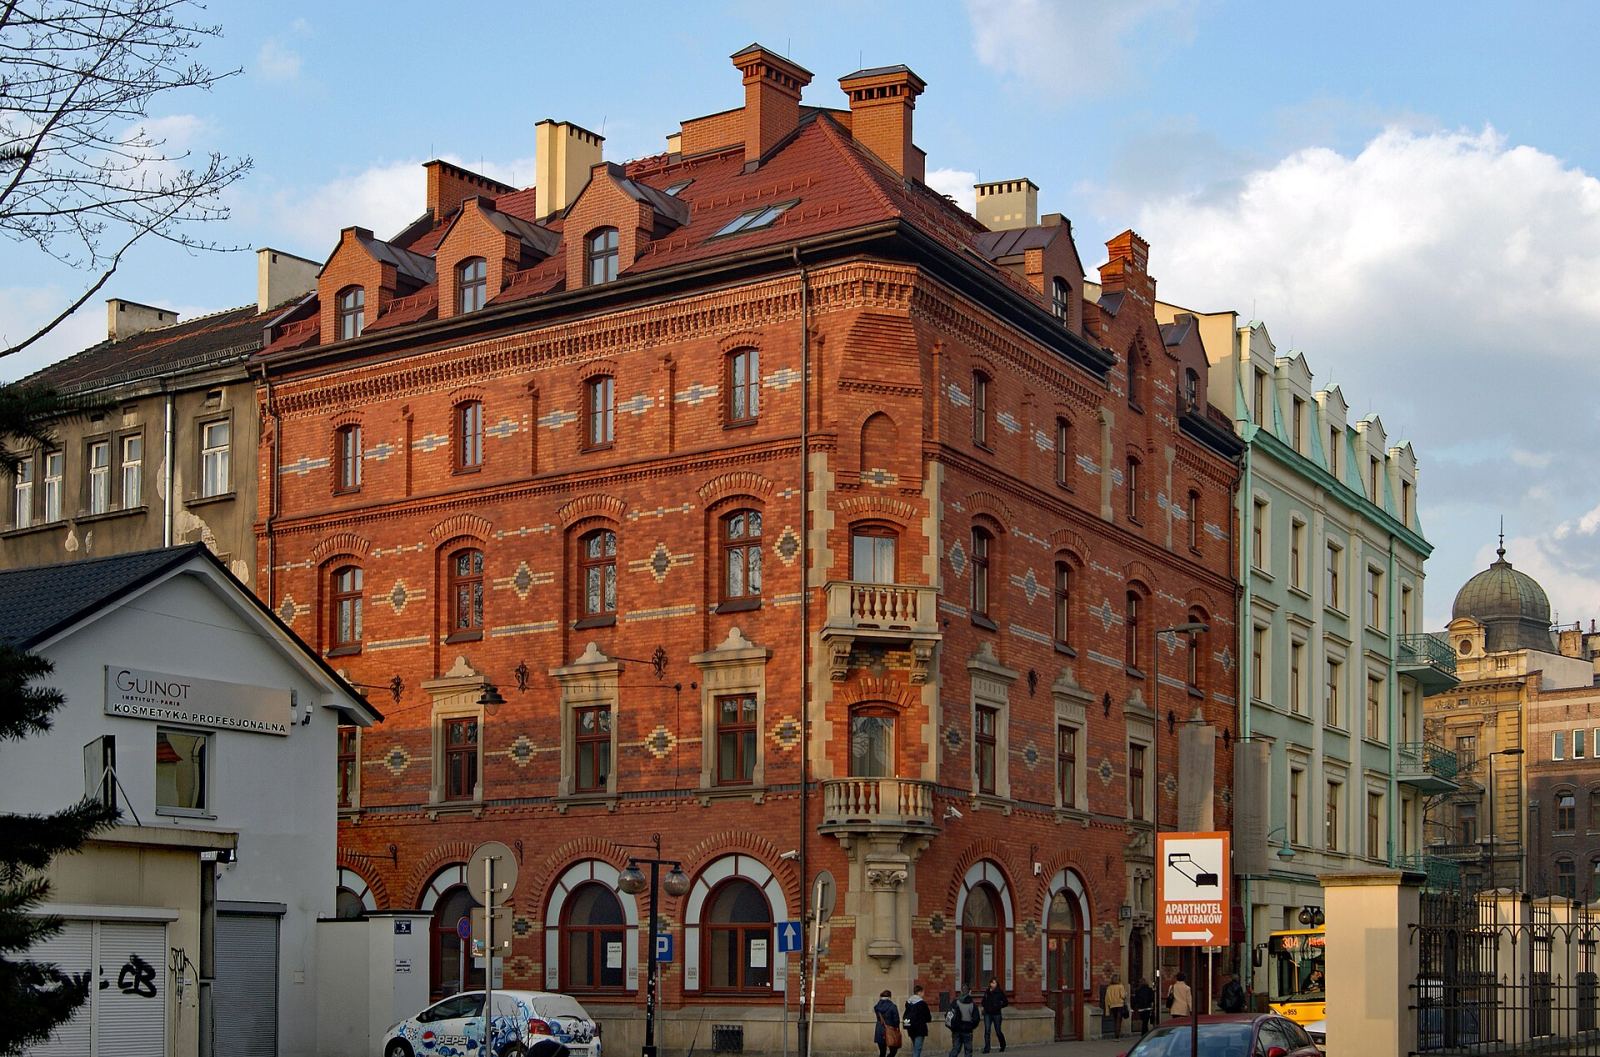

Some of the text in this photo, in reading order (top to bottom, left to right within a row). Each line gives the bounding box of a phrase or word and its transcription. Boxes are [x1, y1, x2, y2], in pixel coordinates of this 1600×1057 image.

[115, 670, 191, 699] GUINOT
[122, 695, 180, 707] INSTITUT PARIS
[114, 704, 286, 733] KOSMETYKA PROFESJONALNA
[1165, 903, 1222, 915] APARTHOTEL
[1165, 912, 1222, 925] MAŁY KRAKÓW
[655, 936, 669, 959] P
[1282, 936, 1299, 949] 304
[438, 1035, 469, 1046] PEPSI
